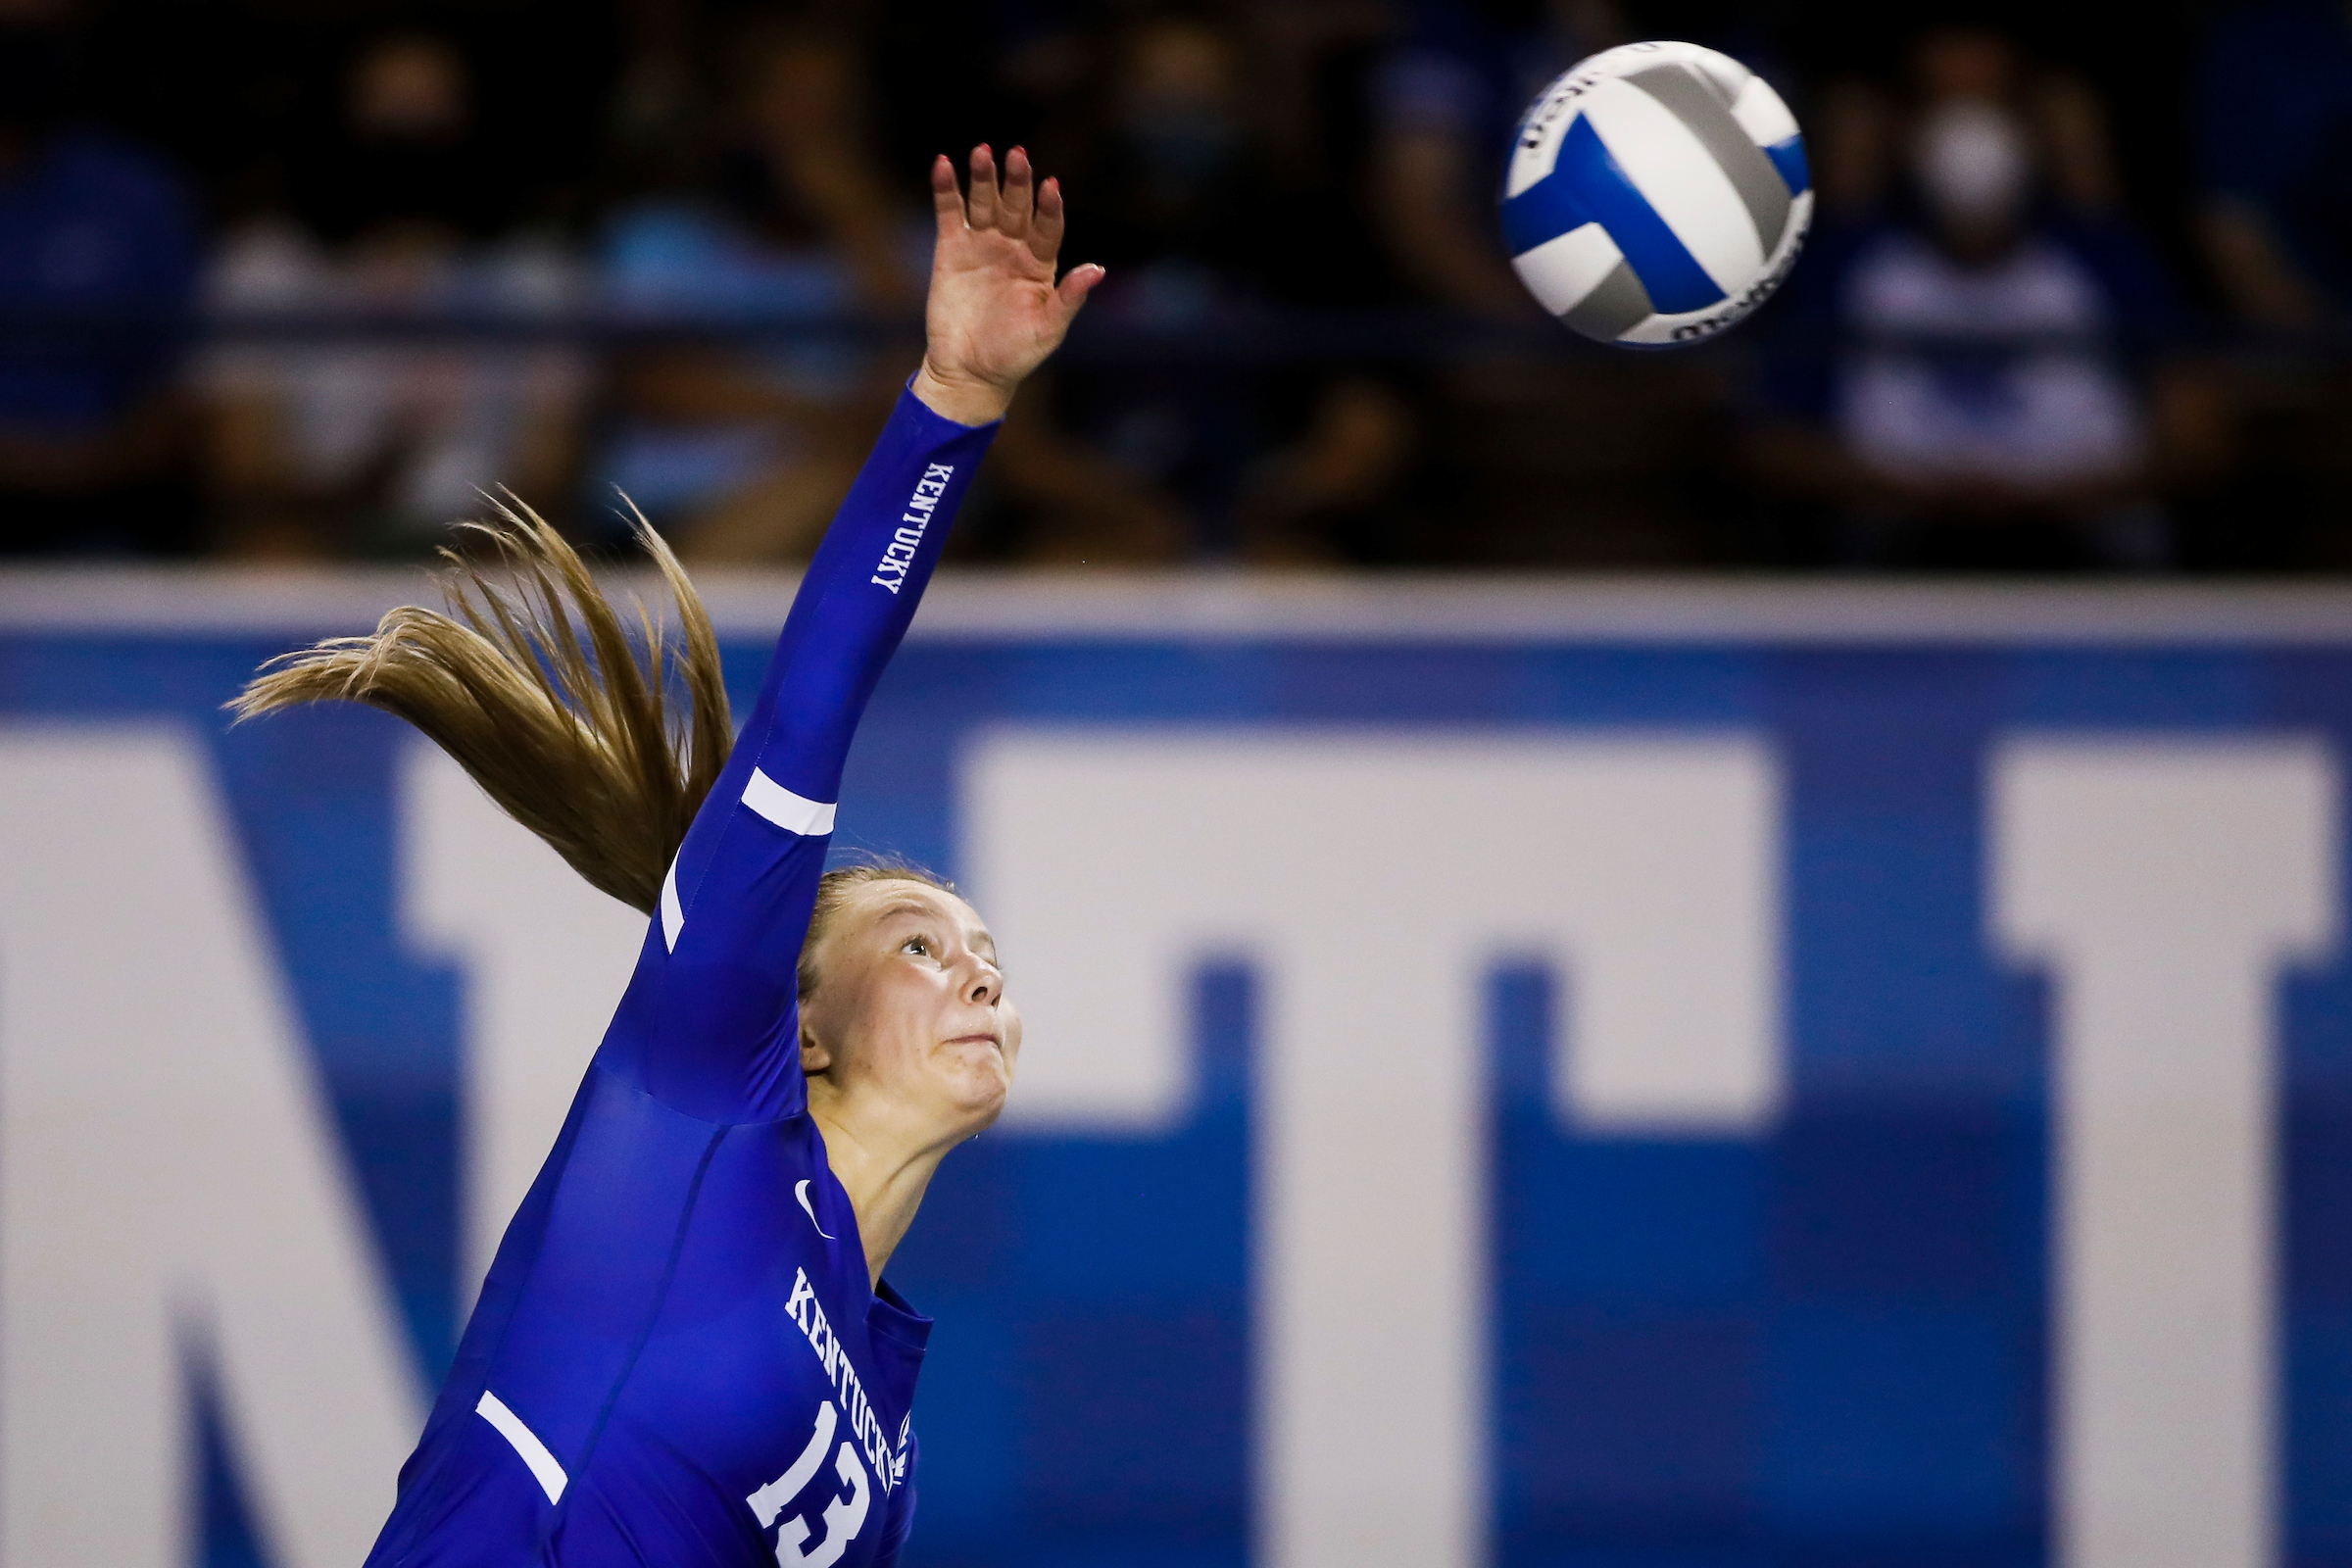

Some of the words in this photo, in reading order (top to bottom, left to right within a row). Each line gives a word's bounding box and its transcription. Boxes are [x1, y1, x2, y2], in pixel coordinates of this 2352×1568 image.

[870, 462, 955, 595] KENTUCKY
[784, 1266, 896, 1497] KENTUCKY
[745, 1399, 871, 1568] 13
